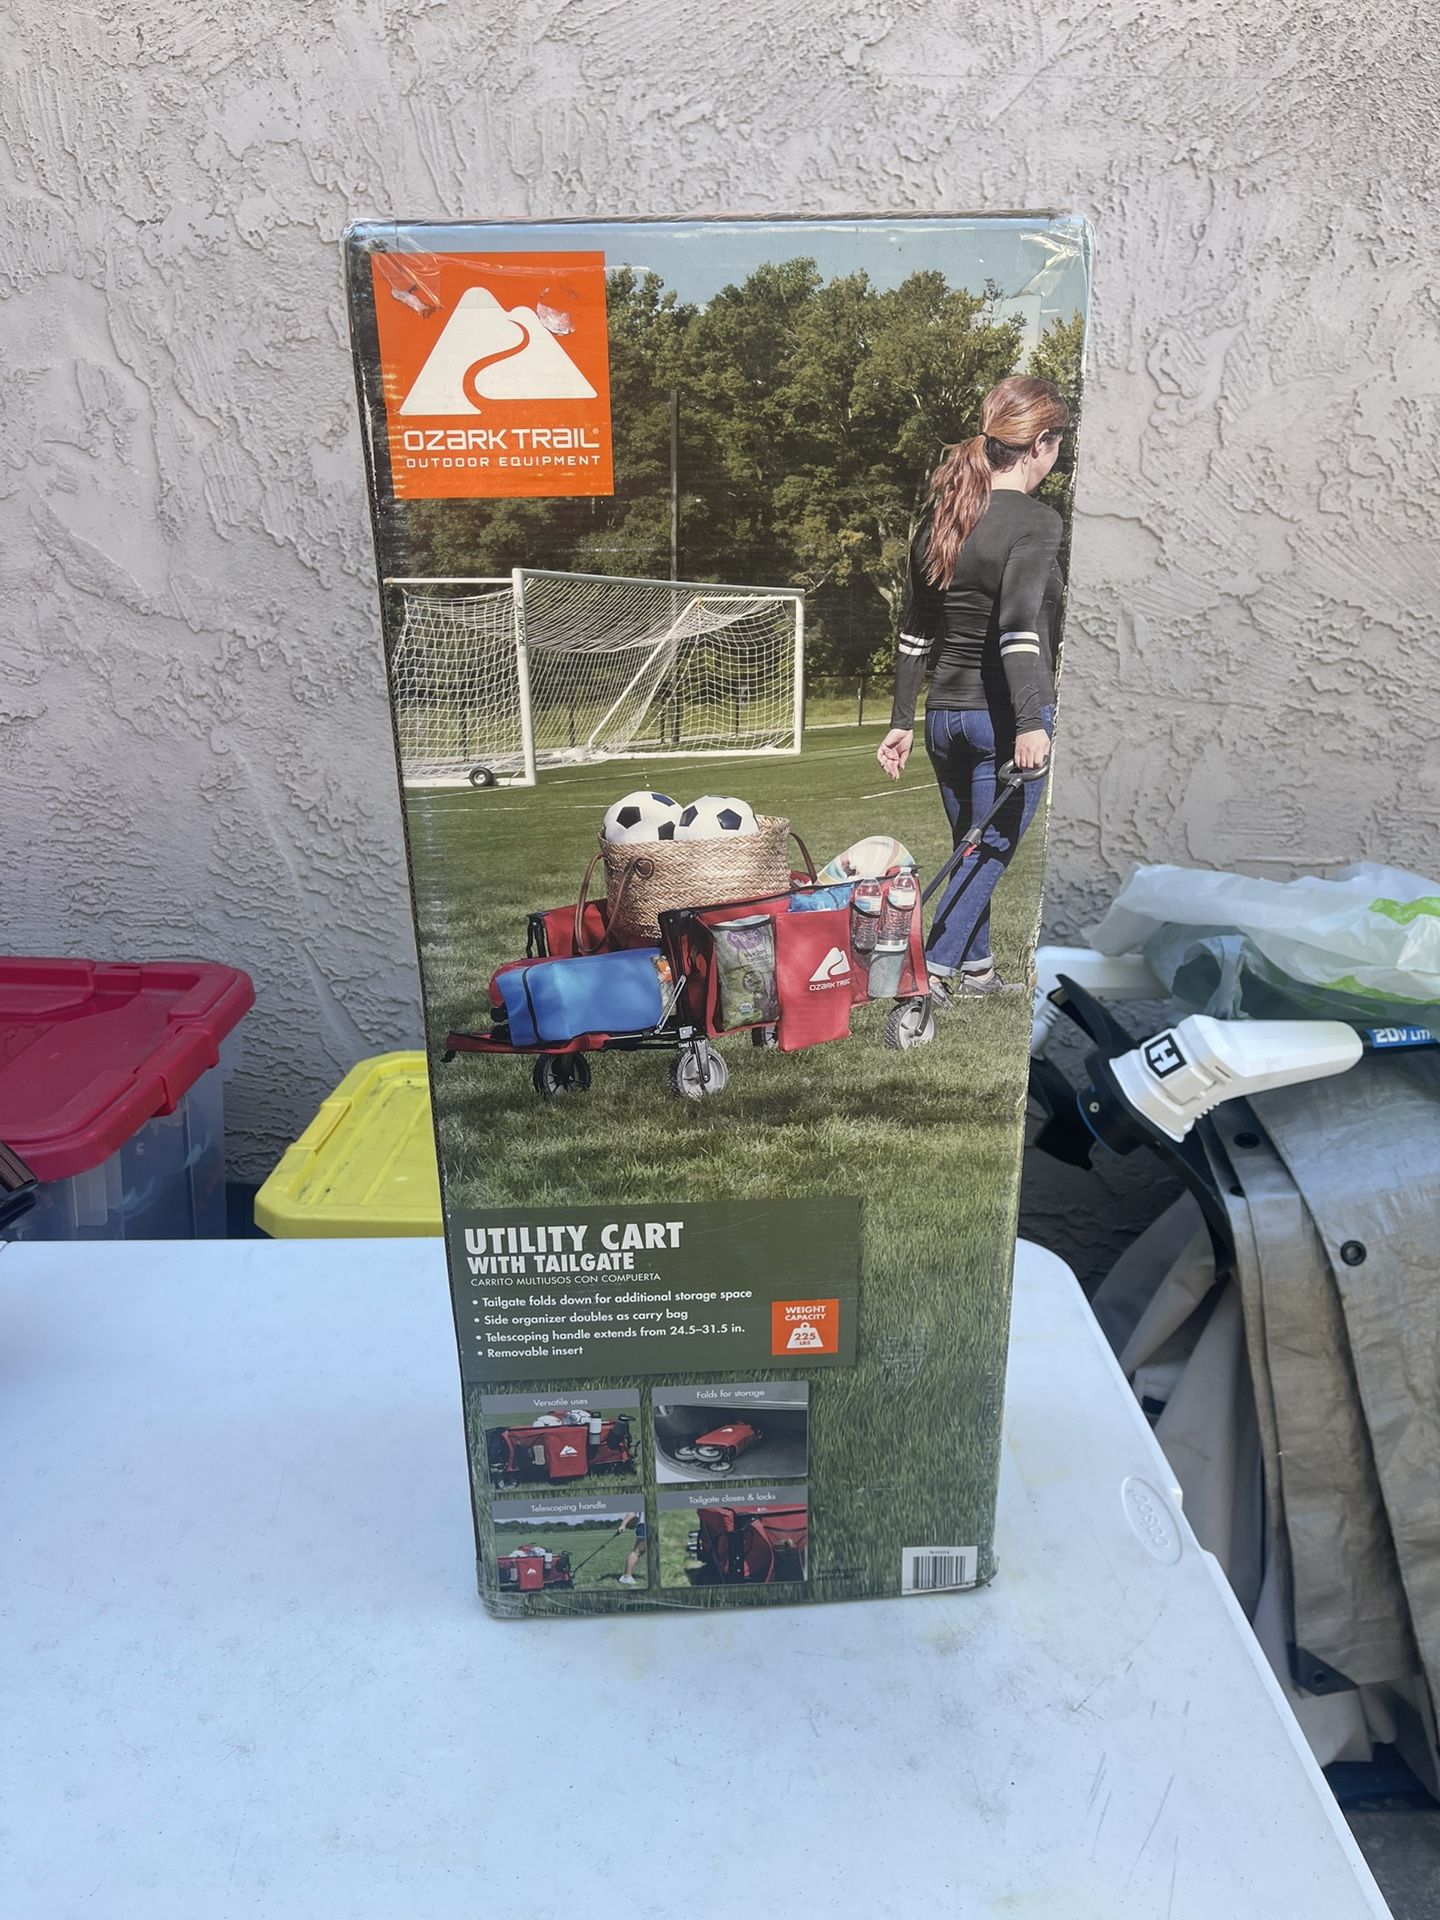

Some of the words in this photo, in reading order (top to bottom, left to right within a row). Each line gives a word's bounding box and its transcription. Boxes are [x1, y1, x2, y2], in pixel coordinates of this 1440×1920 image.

[406, 457, 490, 468] OUTDOOR
[499, 455, 600, 467] EQUIPMENT
[1372, 1027, 1407, 1043] 20V
[464, 1225, 588, 1255] UTILITY
[601, 1222, 684, 1250] CART
[467, 1256, 526, 1275] WITH
[534, 1252, 635, 1273] TAILGATE
[470, 1277, 513, 1287] CARRITO
[517, 1275, 572, 1286] MULTIUSOS
[574, 1275, 598, 1284] CON
[601, 1273, 662, 1283] COMPUERTA
[482, 1296, 526, 1309] Tailgate
[529, 1295, 557, 1307] folds
[560, 1294, 592, 1305] down
[595, 1293, 612, 1304] for
[614, 1290, 672, 1303] additional
[675, 1291, 717, 1303] storage
[720, 1290, 753, 1301] space
[785, 1305, 826, 1314] WEIGHT
[484, 1314, 509, 1325] Side
[512, 1313, 566, 1326] organizer
[569, 1311, 613, 1322] doubles
[616, 1313, 630, 1321] as
[632, 1312, 663, 1322] carry
[666, 1308, 689, 1321] bag
[784, 1313, 826, 1321] CAPACITY
[485, 1331, 549, 1344] Telescoping
[552, 1329, 591, 1340] handle
[594, 1327, 638, 1339] extends
[640, 1326, 667, 1337] from
[731, 1323, 745, 1333] in.
[794, 1332, 816, 1341] 225
[487, 1346, 549, 1358] Removable
[552, 1346, 584, 1356] insert
[696, 1389, 718, 1399] Folds
[720, 1389, 732, 1398] for
[734, 1390, 765, 1399] storage
[533, 1397, 568, 1407] Versatile
[688, 1495, 720, 1506] Tailgate
[721, 1493, 745, 1503] closes
[747, 1493, 754, 1502] &
[756, 1491, 776, 1501] locks
[531, 1503, 577, 1513] Telescoping
[578, 1500, 607, 1510] handle
